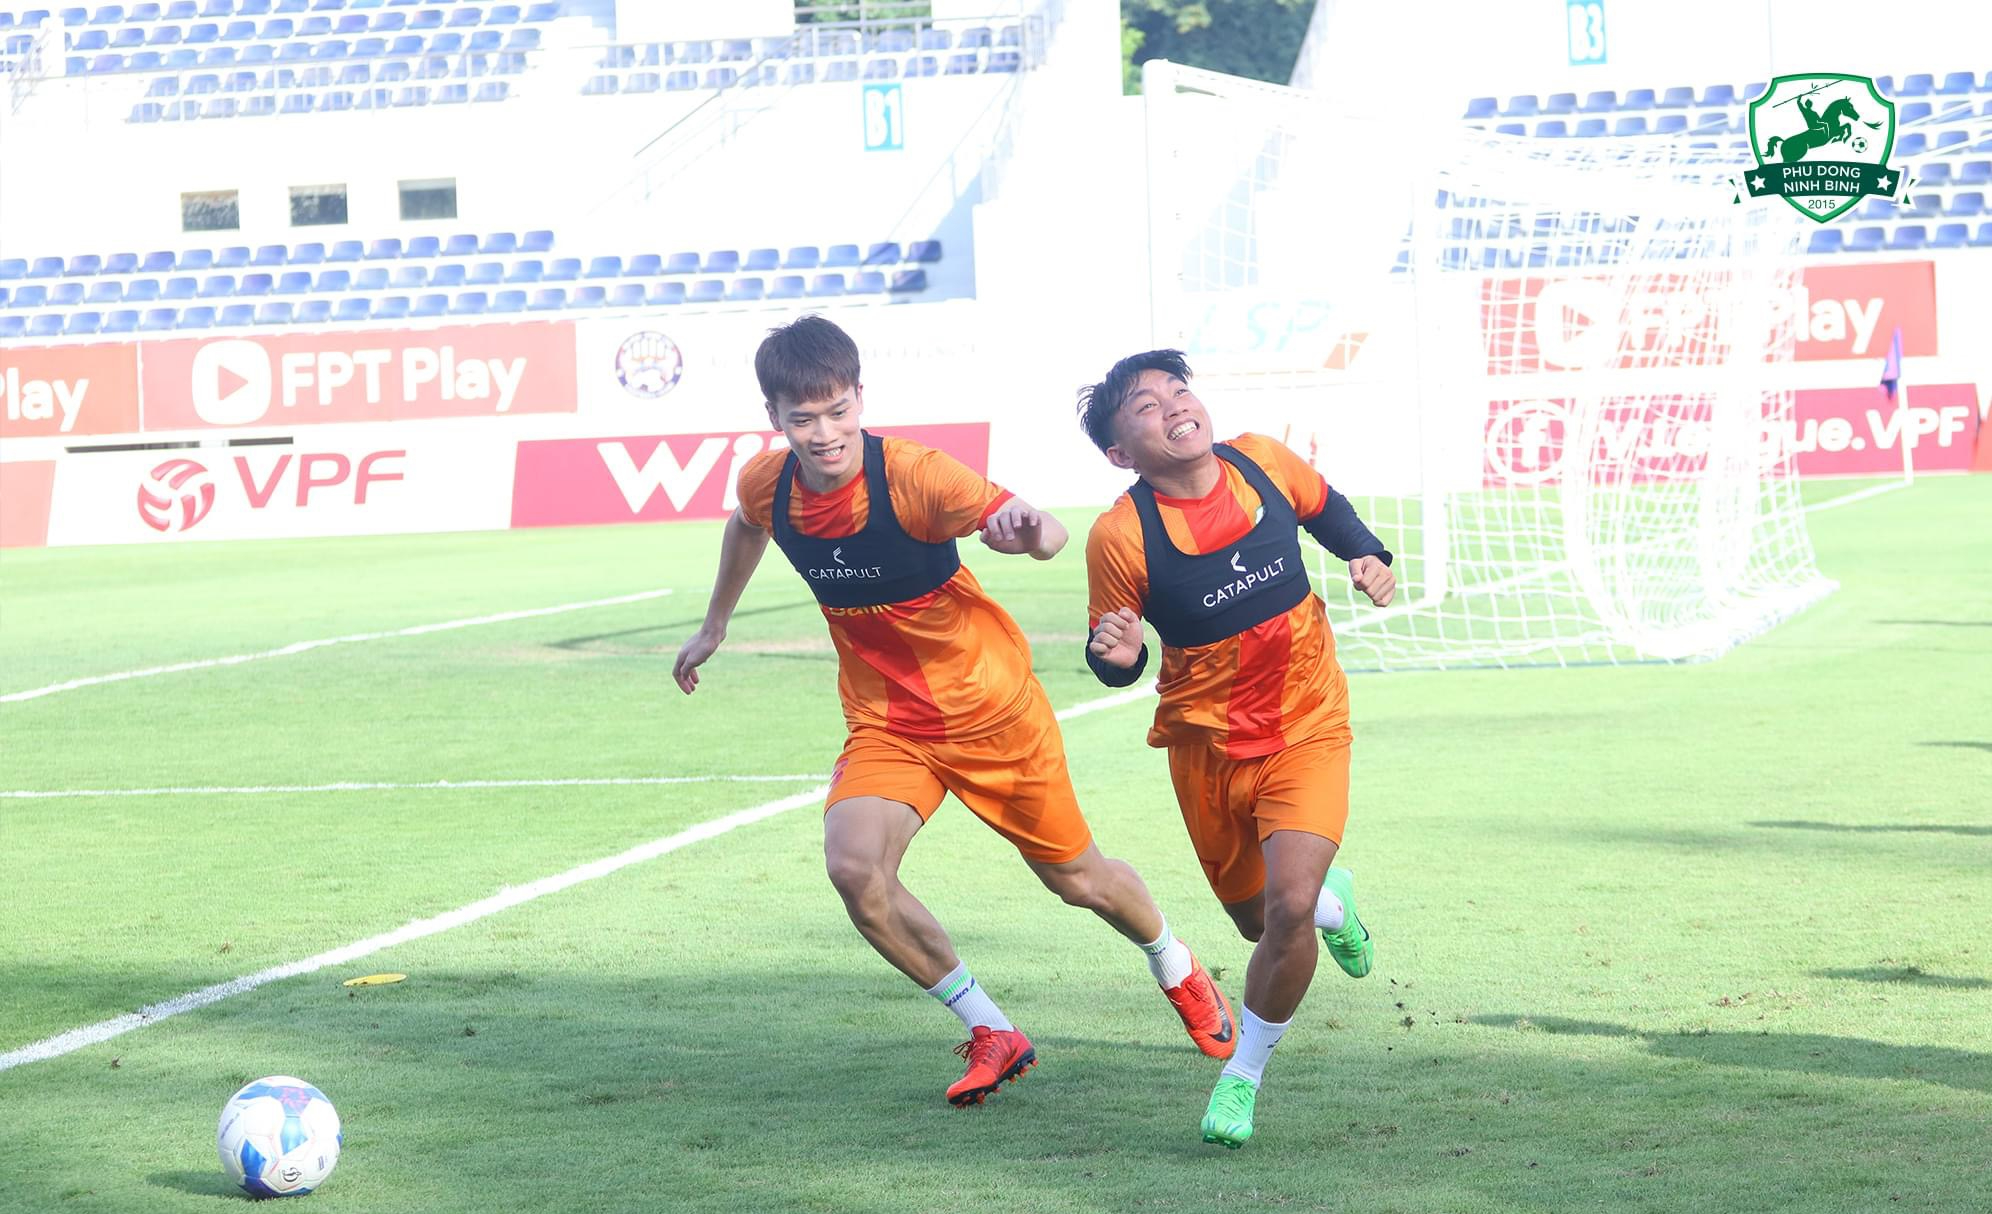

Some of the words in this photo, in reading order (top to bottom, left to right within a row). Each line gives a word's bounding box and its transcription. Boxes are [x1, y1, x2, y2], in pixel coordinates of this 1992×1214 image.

[1569, 3, 1605, 61] B3
[864, 87, 902, 147] B1
[1188, 299, 1336, 354] LSP
[281, 350, 391, 407] FPT
[403, 346, 527, 412] Play
[233, 450, 406, 508] VPF
[596, 433, 789, 515] Wi
[808, 566, 882, 580] CATAPULT
[1203, 557, 1286, 608] CATAPULT
